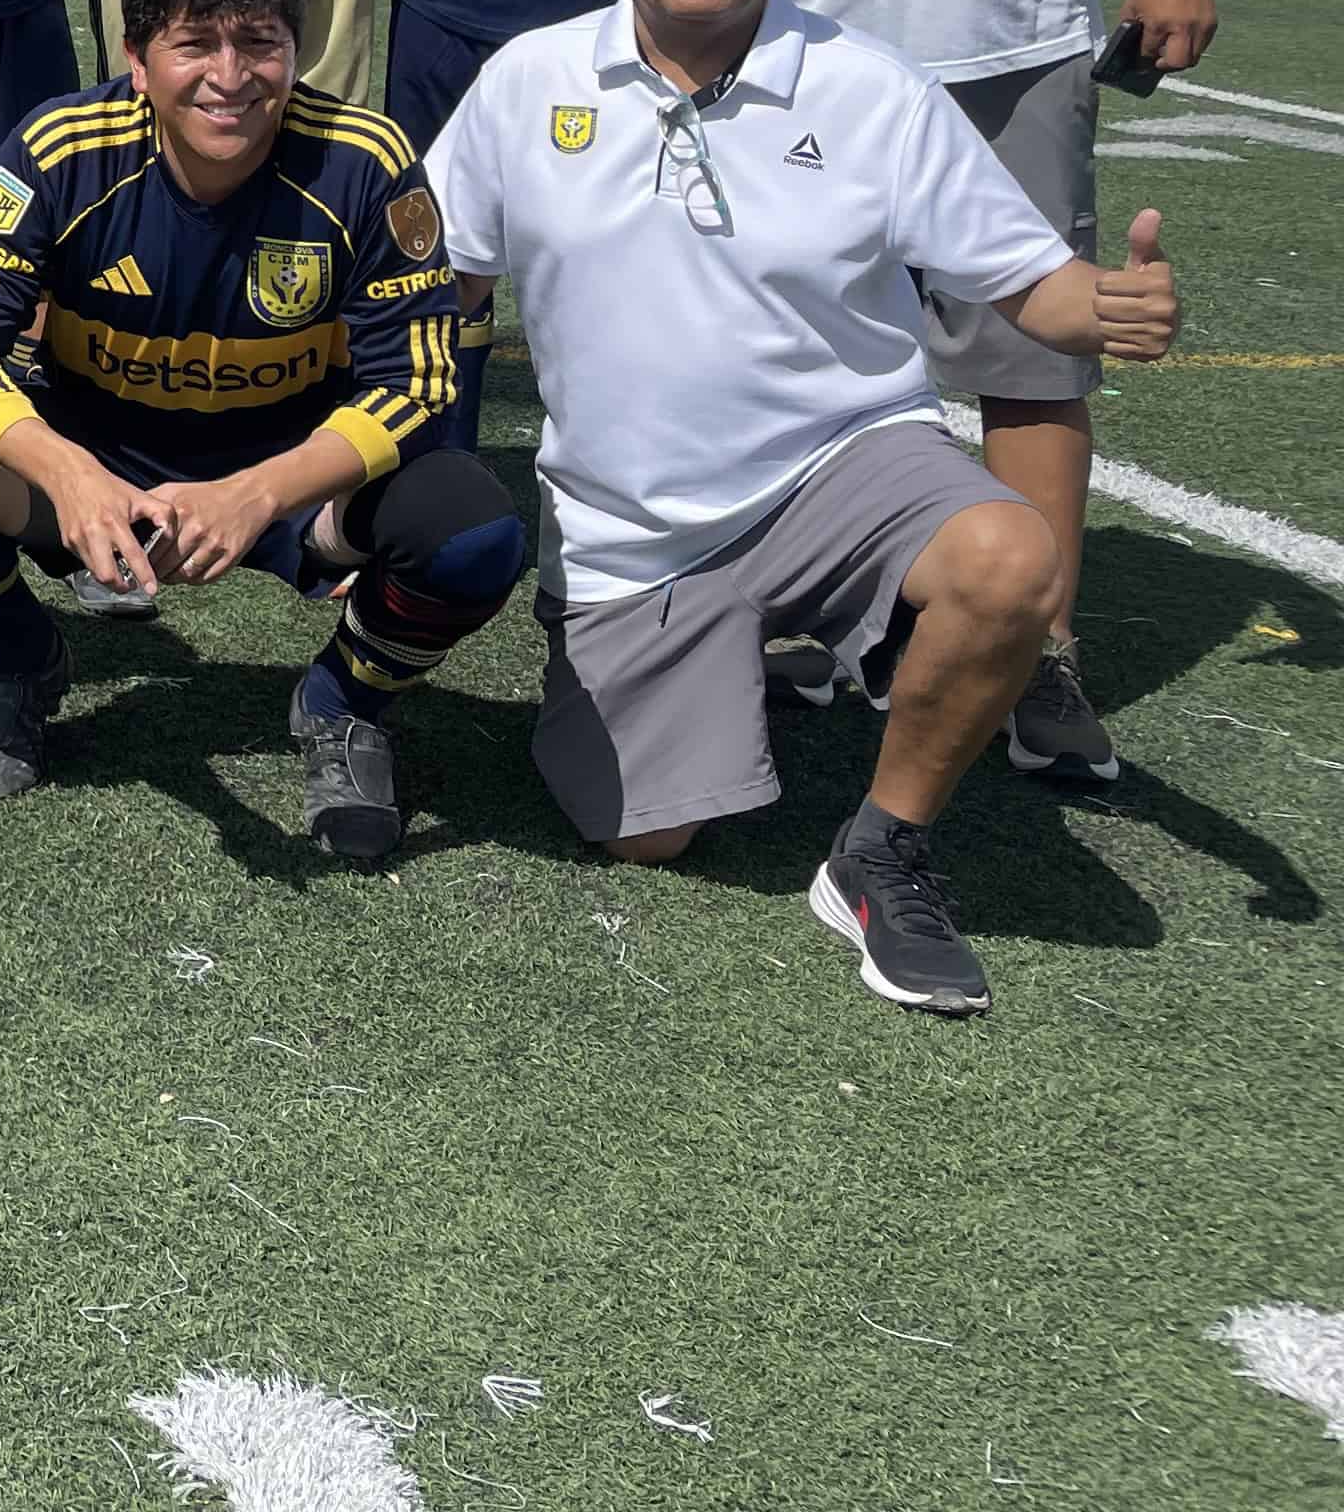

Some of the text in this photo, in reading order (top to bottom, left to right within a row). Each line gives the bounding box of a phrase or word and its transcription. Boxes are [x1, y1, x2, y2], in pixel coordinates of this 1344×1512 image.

[783, 155, 825, 172] Reebok
[268, 253, 309, 266] C.D.M
[87, 332, 318, 393] betsson
